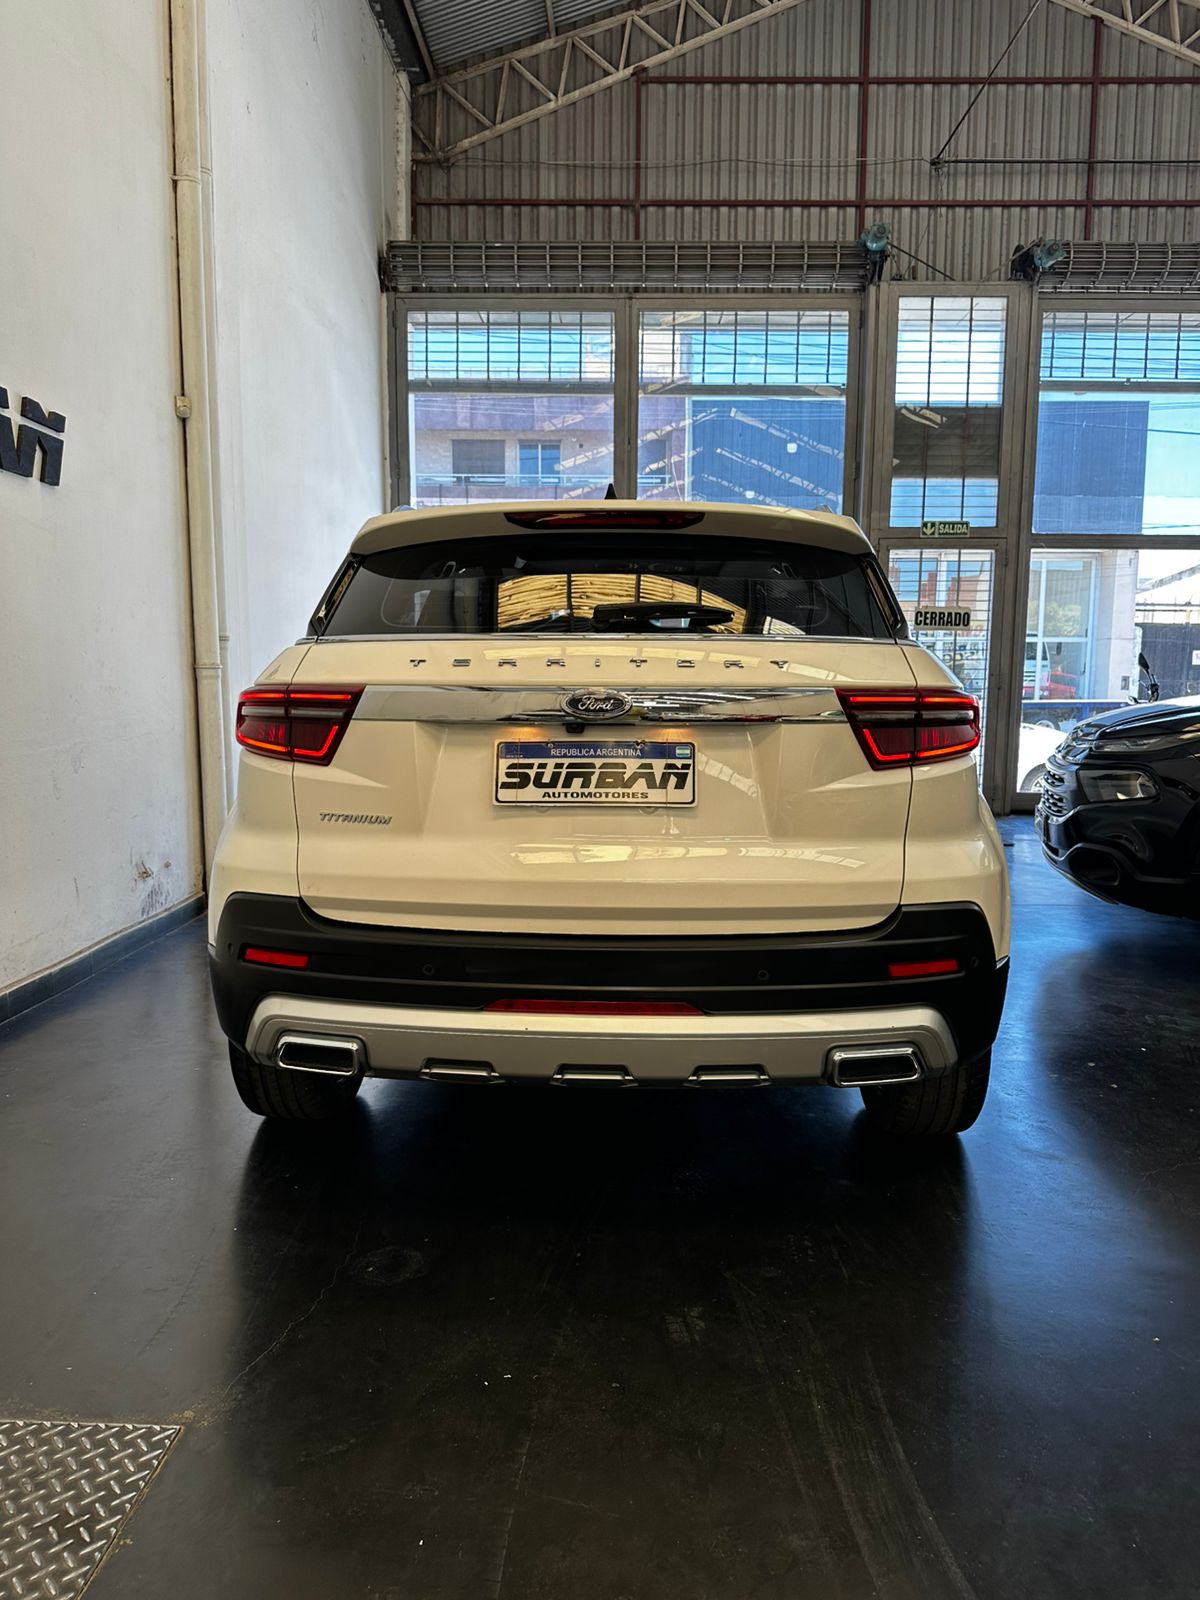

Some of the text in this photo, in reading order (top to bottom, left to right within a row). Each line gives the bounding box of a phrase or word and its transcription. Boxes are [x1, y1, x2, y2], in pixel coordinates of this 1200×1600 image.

[939, 524, 968, 533] SALIDA
[915, 611, 970, 627] CERRADO
[409, 658, 789, 669] TERRITORY
[578, 695, 614, 710] Ford
[550, 748, 641, 757] REPUBLICA ARGENTINA
[499, 762, 691, 789] SURBAN
[541, 791, 649, 799] AUTOMOTORES
[320, 813, 392, 825] TITANIUM
